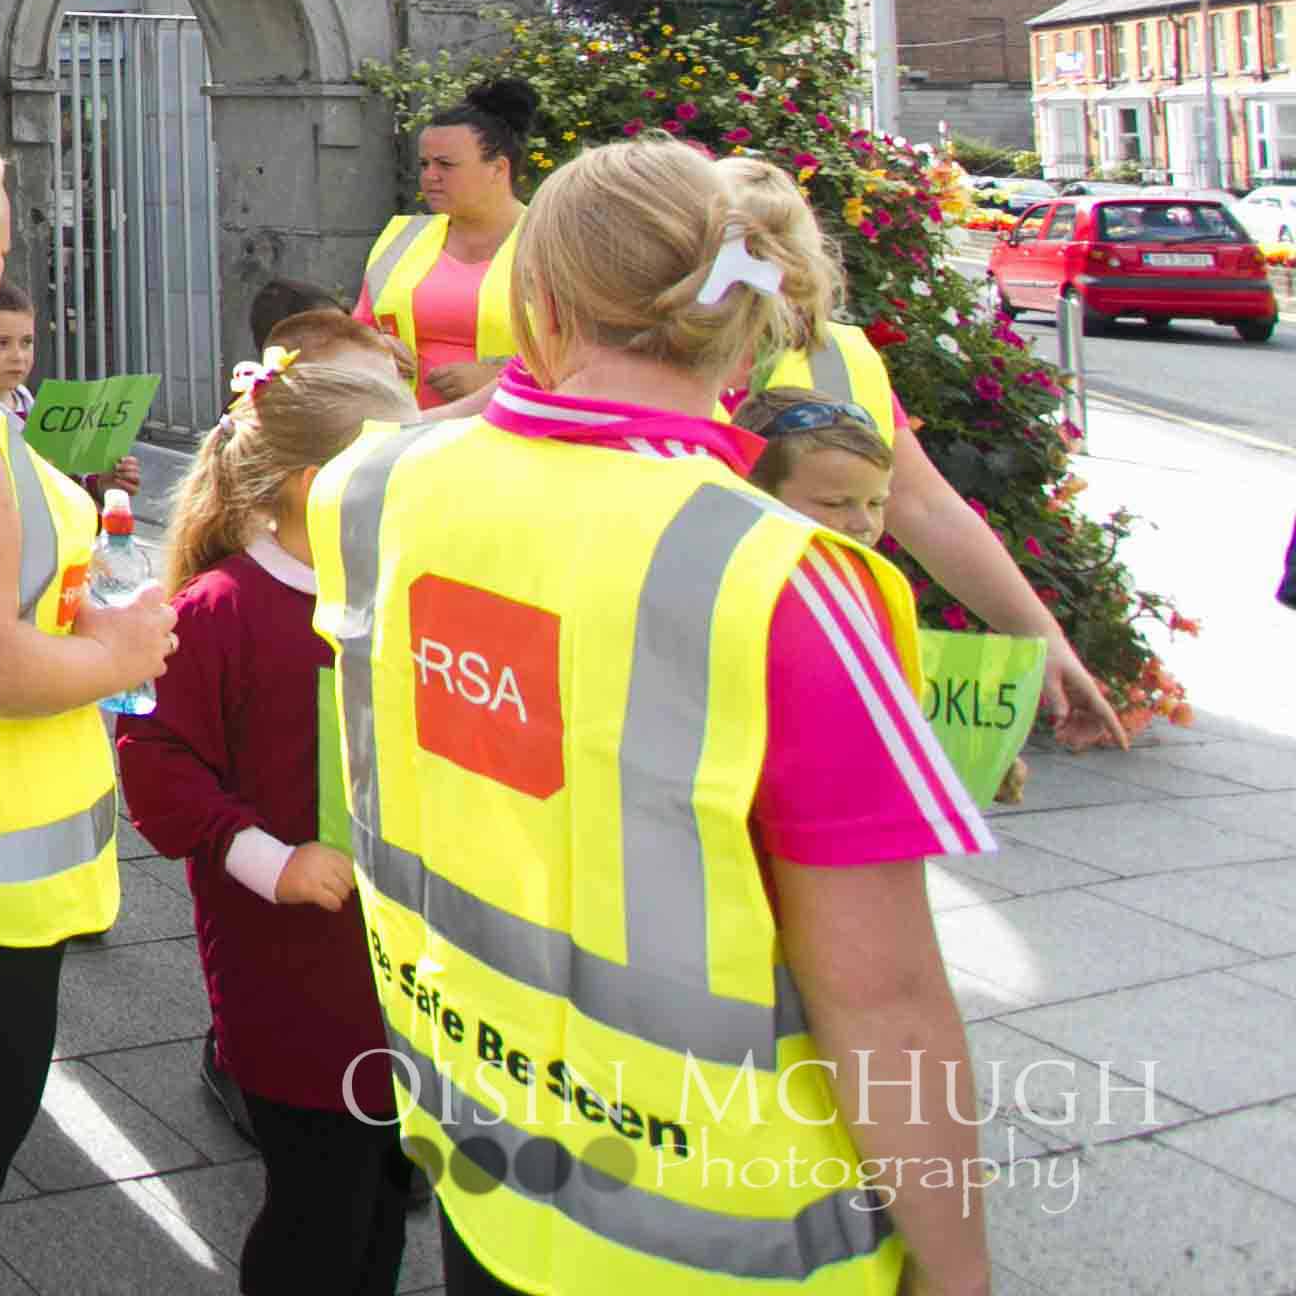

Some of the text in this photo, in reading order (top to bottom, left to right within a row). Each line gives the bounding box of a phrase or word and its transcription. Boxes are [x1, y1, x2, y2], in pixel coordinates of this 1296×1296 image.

[39, 400, 134, 433] CDKL5
[418, 635, 528, 725] RSA
[399, 963, 465, 1043] Safe
[477, 1018, 535, 1086] Be
[545, 1059, 689, 1158] Seen
